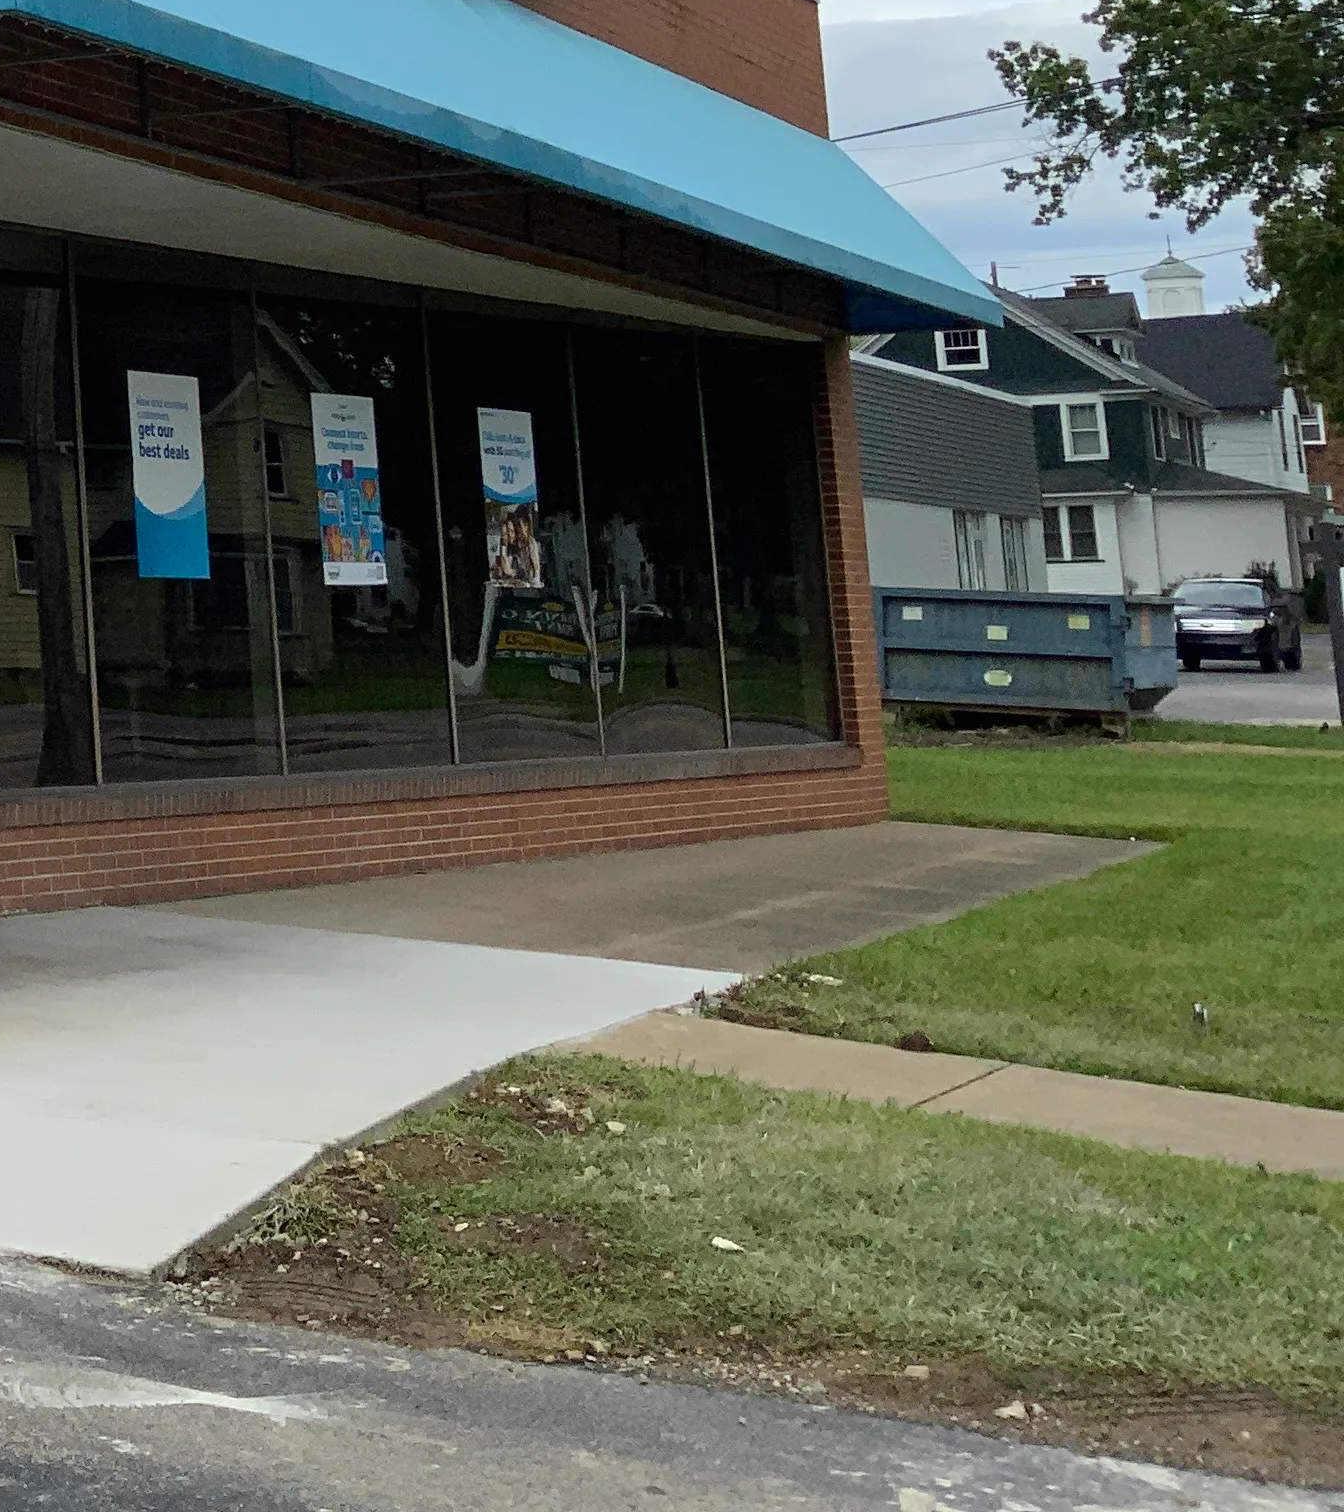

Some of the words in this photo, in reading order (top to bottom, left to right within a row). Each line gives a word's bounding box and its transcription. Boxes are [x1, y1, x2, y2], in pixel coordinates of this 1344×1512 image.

[138, 423, 155, 440] get
[157, 425, 174, 438] our
[139, 441, 161, 458] best
[163, 443, 190, 460] deals
